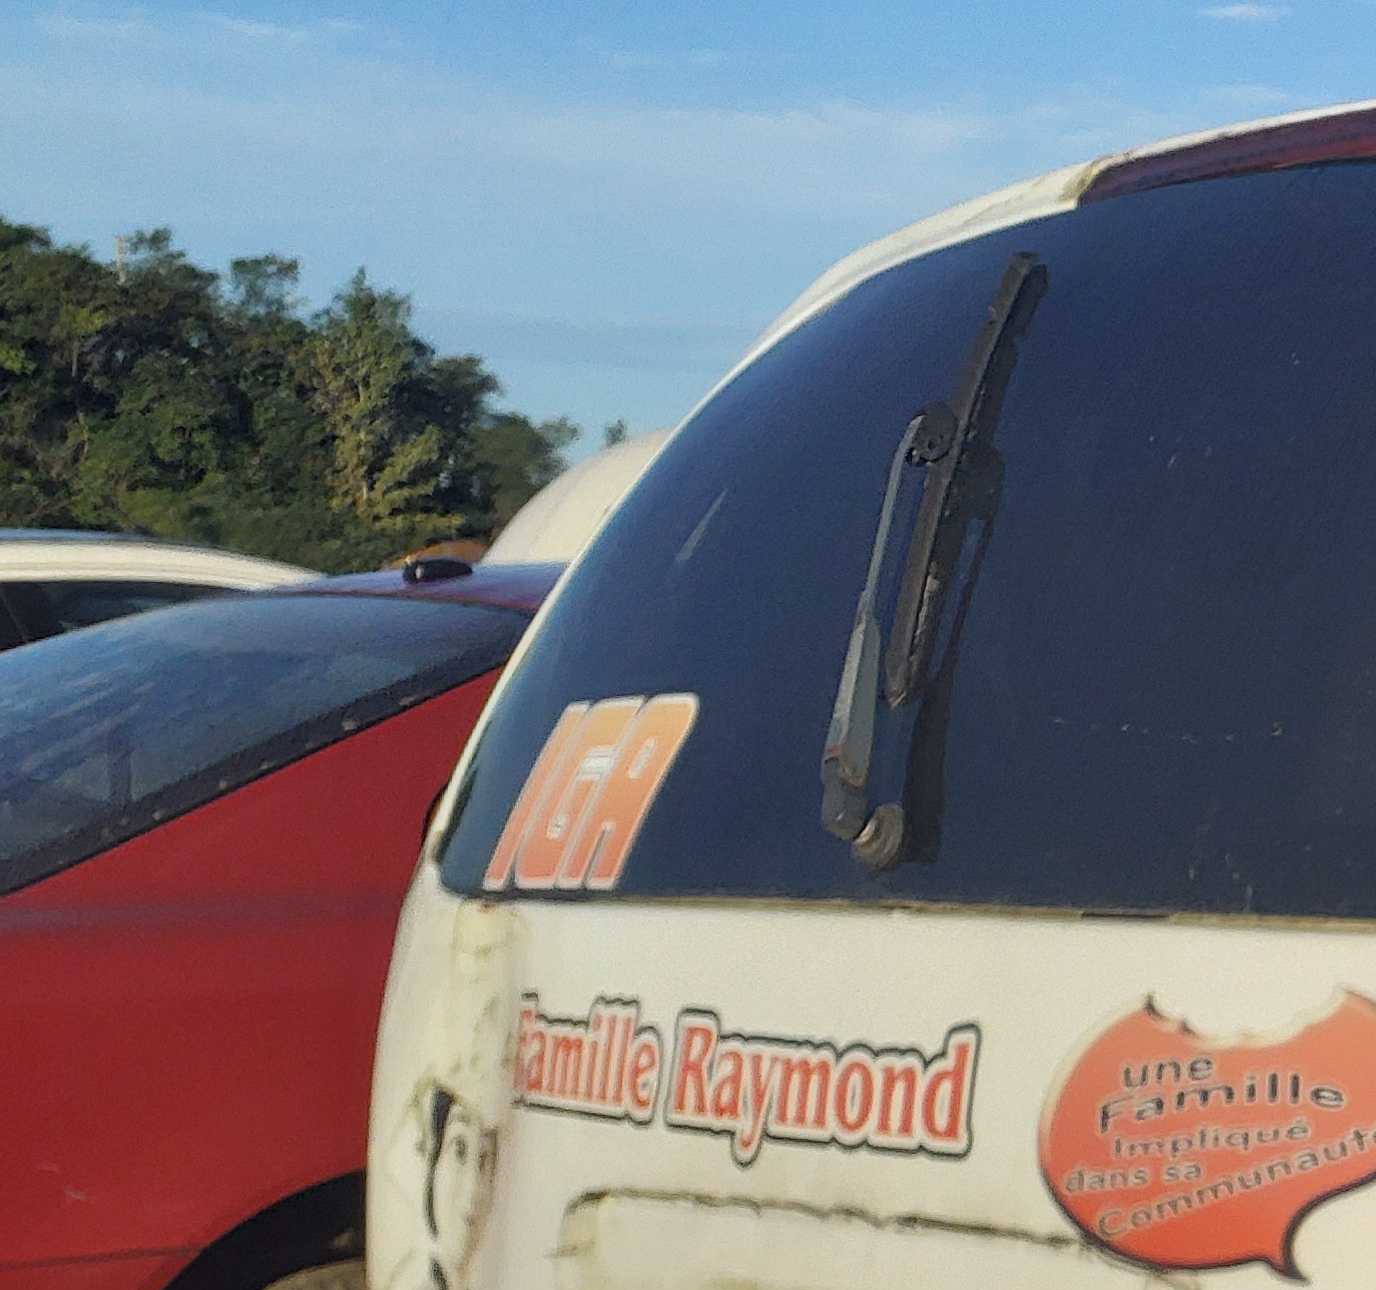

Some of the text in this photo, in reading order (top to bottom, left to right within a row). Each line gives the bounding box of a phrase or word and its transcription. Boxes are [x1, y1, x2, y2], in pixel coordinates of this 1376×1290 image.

[668, 1014, 977, 1160] Raymond
[1121, 1055, 1214, 1090] une
[1098, 1072, 1346, 1133] Famille
[1063, 1161, 1203, 1194] dans sa
